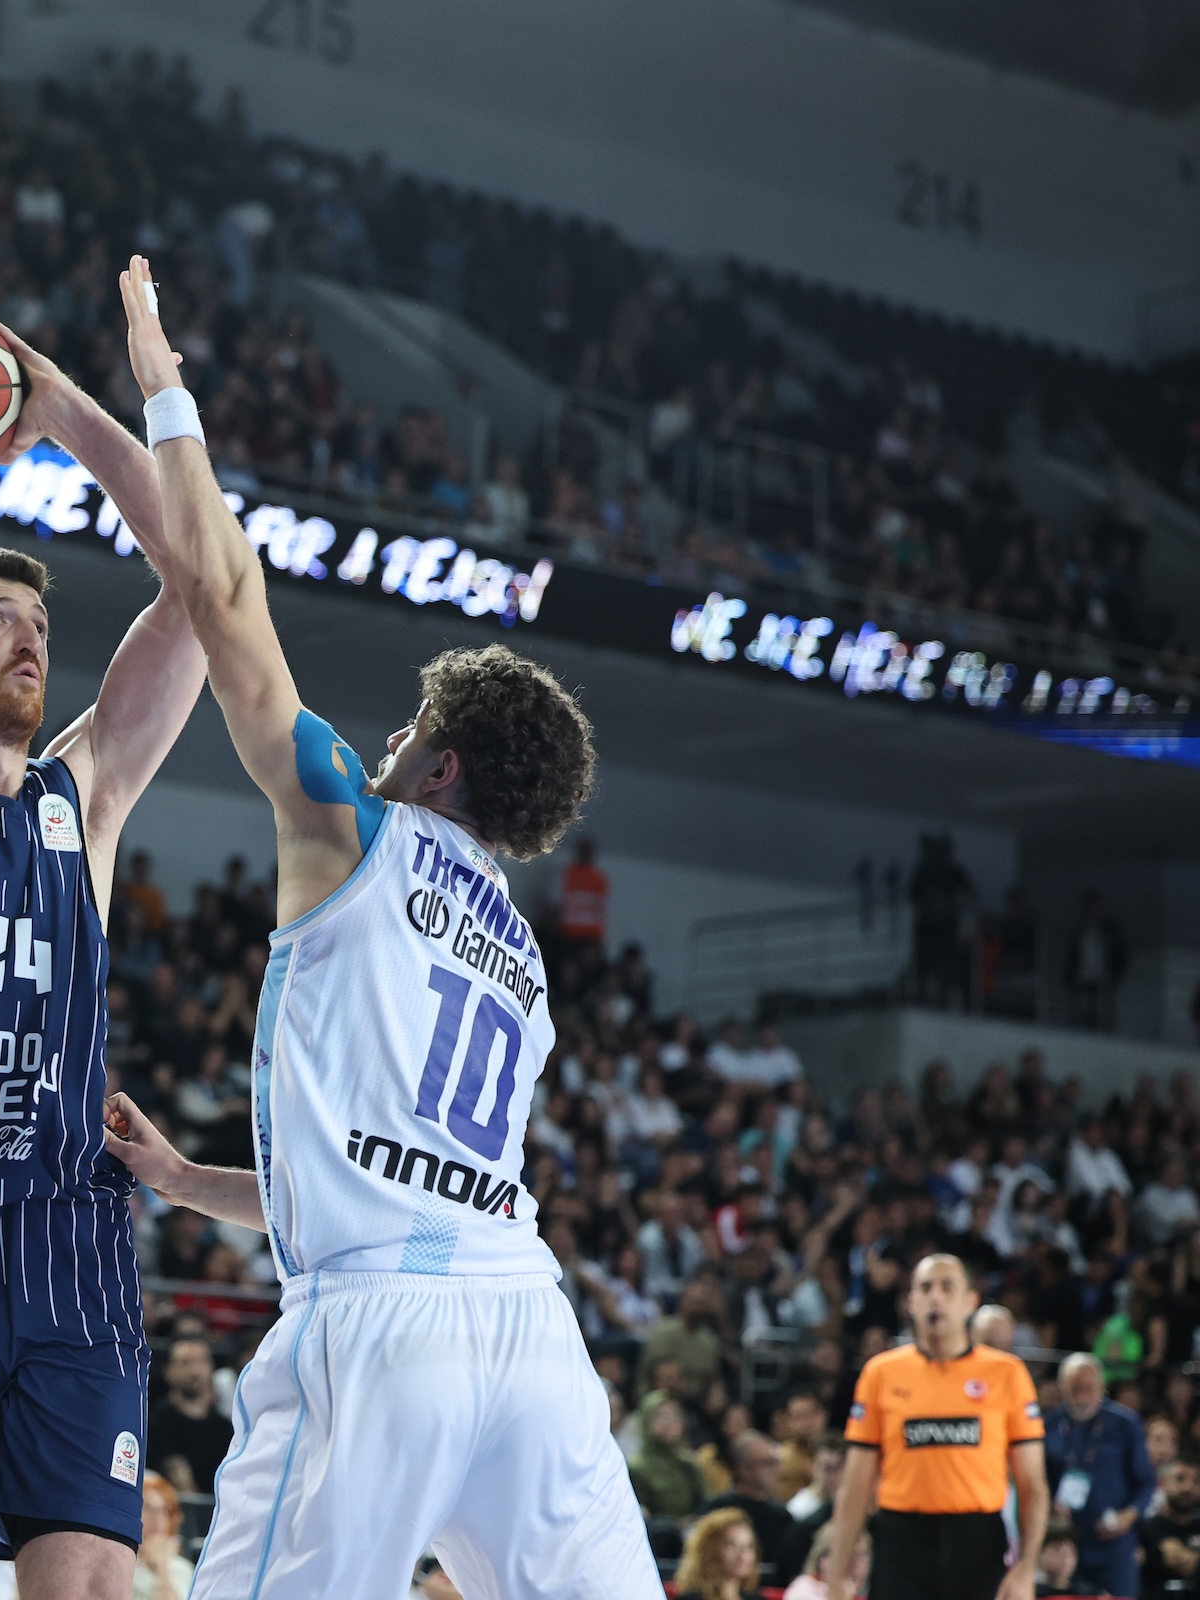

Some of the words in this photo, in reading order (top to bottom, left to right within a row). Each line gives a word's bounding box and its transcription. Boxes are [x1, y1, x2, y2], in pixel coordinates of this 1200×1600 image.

[894, 159, 985, 238] 214
[337, 526, 379, 585] A
[452, 913, 545, 1018] Gamador
[414, 964, 522, 1162] 10
